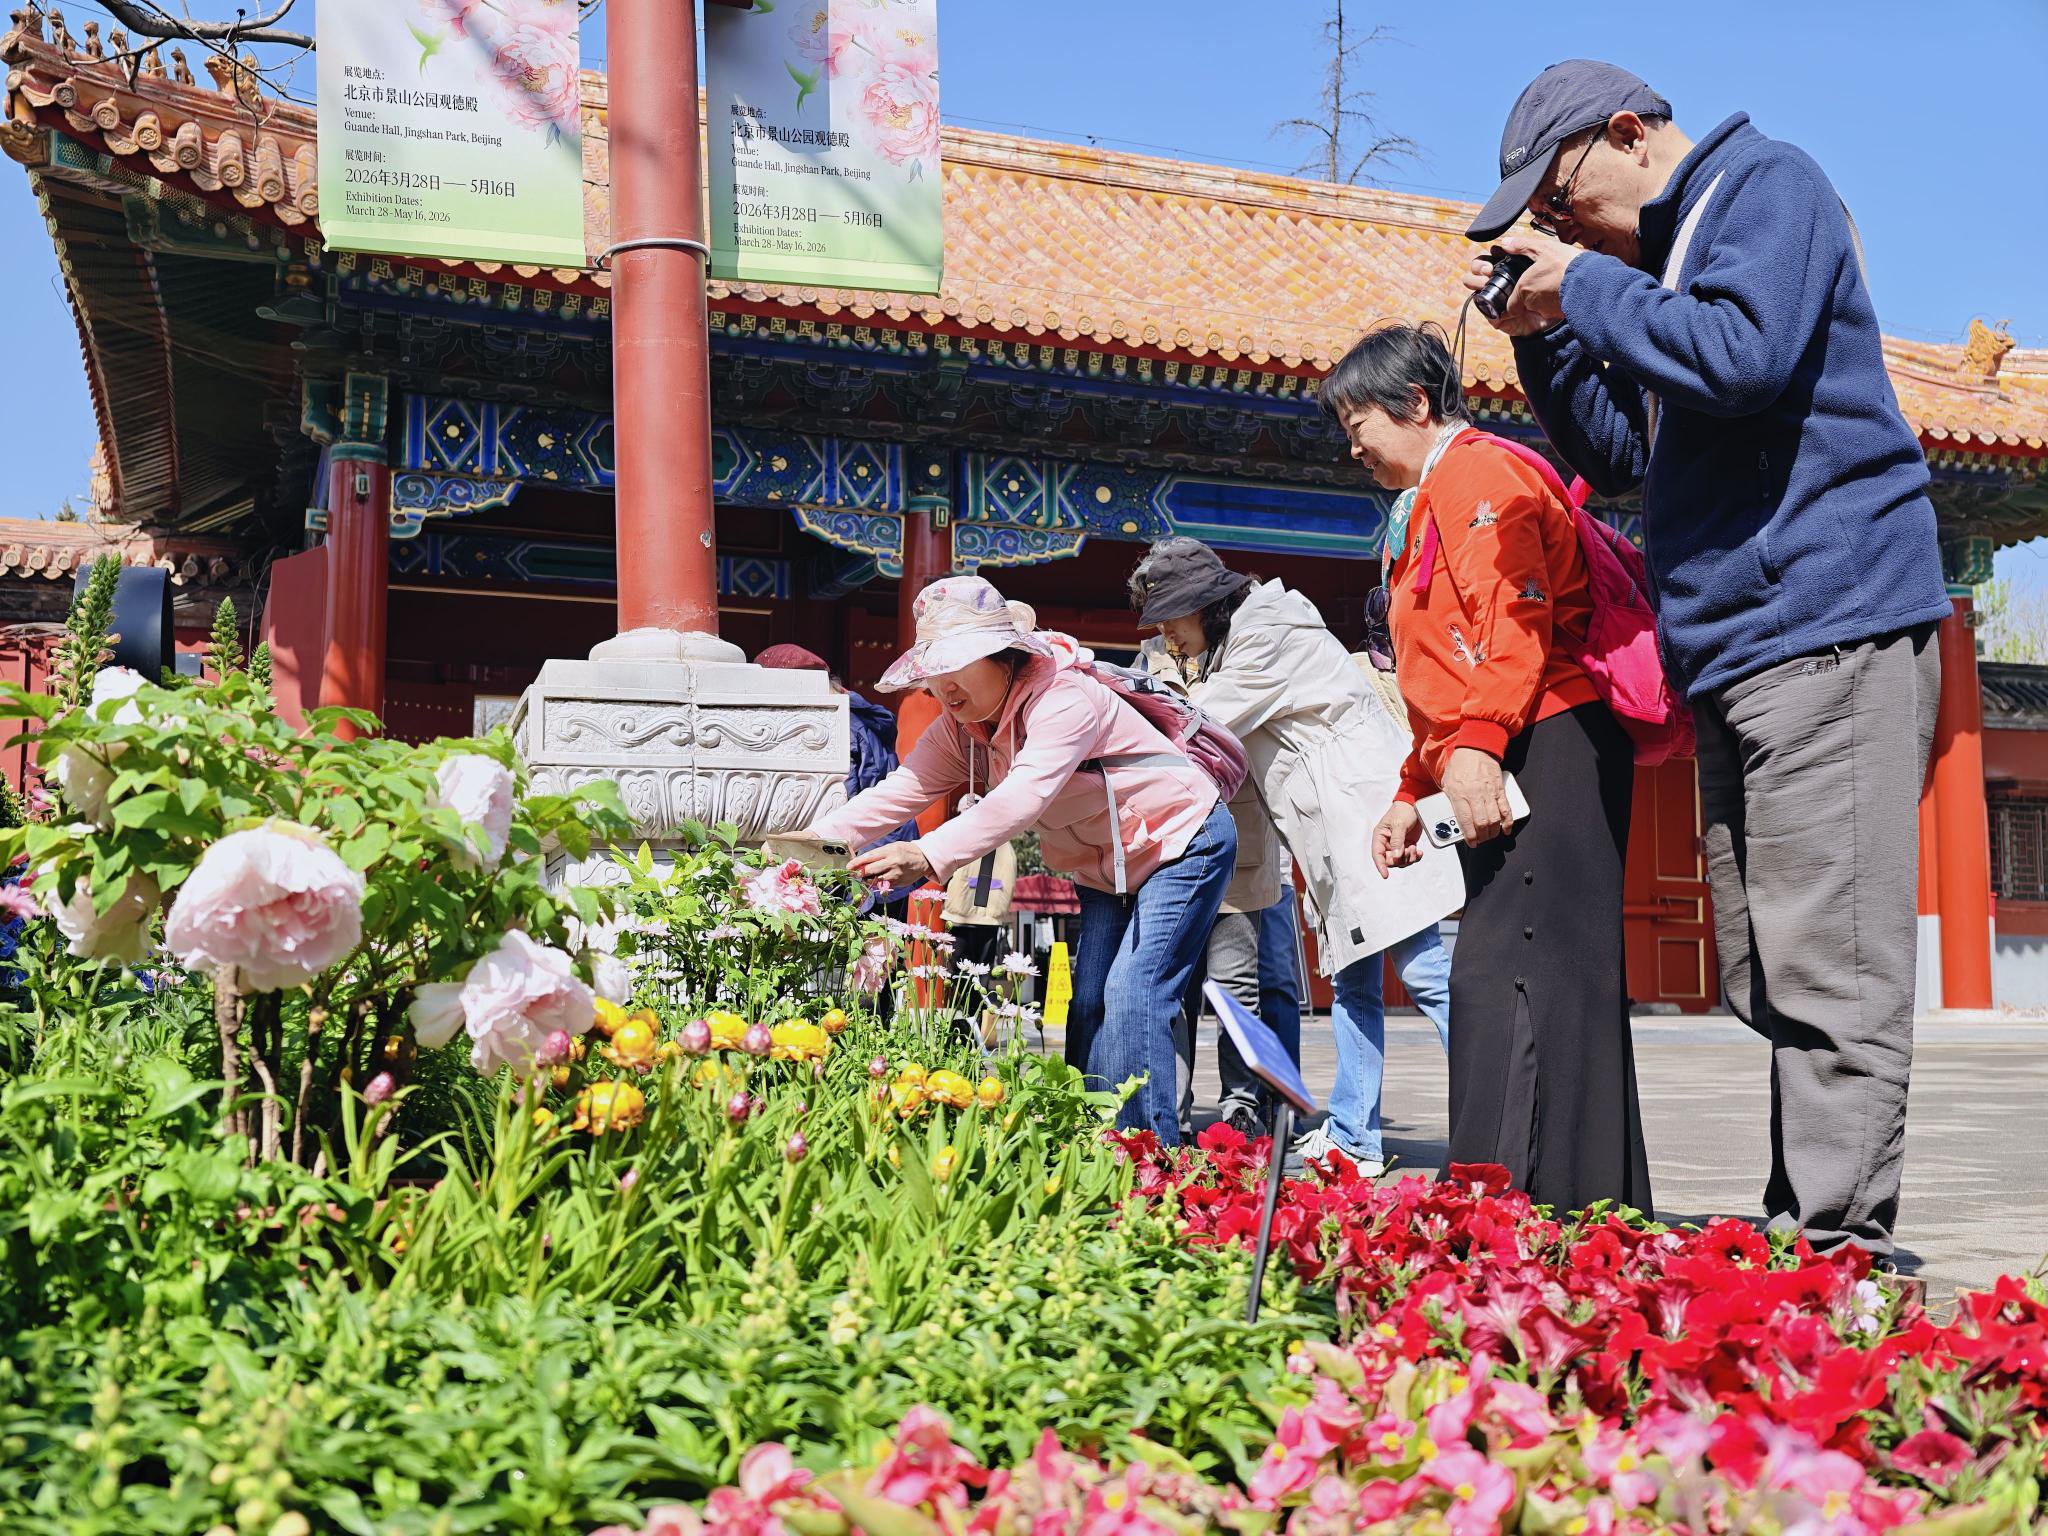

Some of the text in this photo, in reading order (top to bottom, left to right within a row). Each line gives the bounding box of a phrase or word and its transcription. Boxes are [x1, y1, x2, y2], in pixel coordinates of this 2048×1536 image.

[344, 84, 479, 113] 北京市景山公园观德殿
[345, 107, 376, 120] Venue:
[344, 121, 502, 147] Guande Hall, Jingshan Park, Beijing
[731, 121, 850, 148] 北京市景山公园观德殿
[731, 156, 871, 181] Guande Hall, Jingshan Park, Beijing
[345, 191, 423, 207] Exhibition Dates:
[346, 205, 375, 217] March
[428, 211, 451, 222] 2026
[734, 223, 802, 238] Exhibition Dates:
[734, 236, 760, 248] March
[807, 242, 826, 252] 2026
